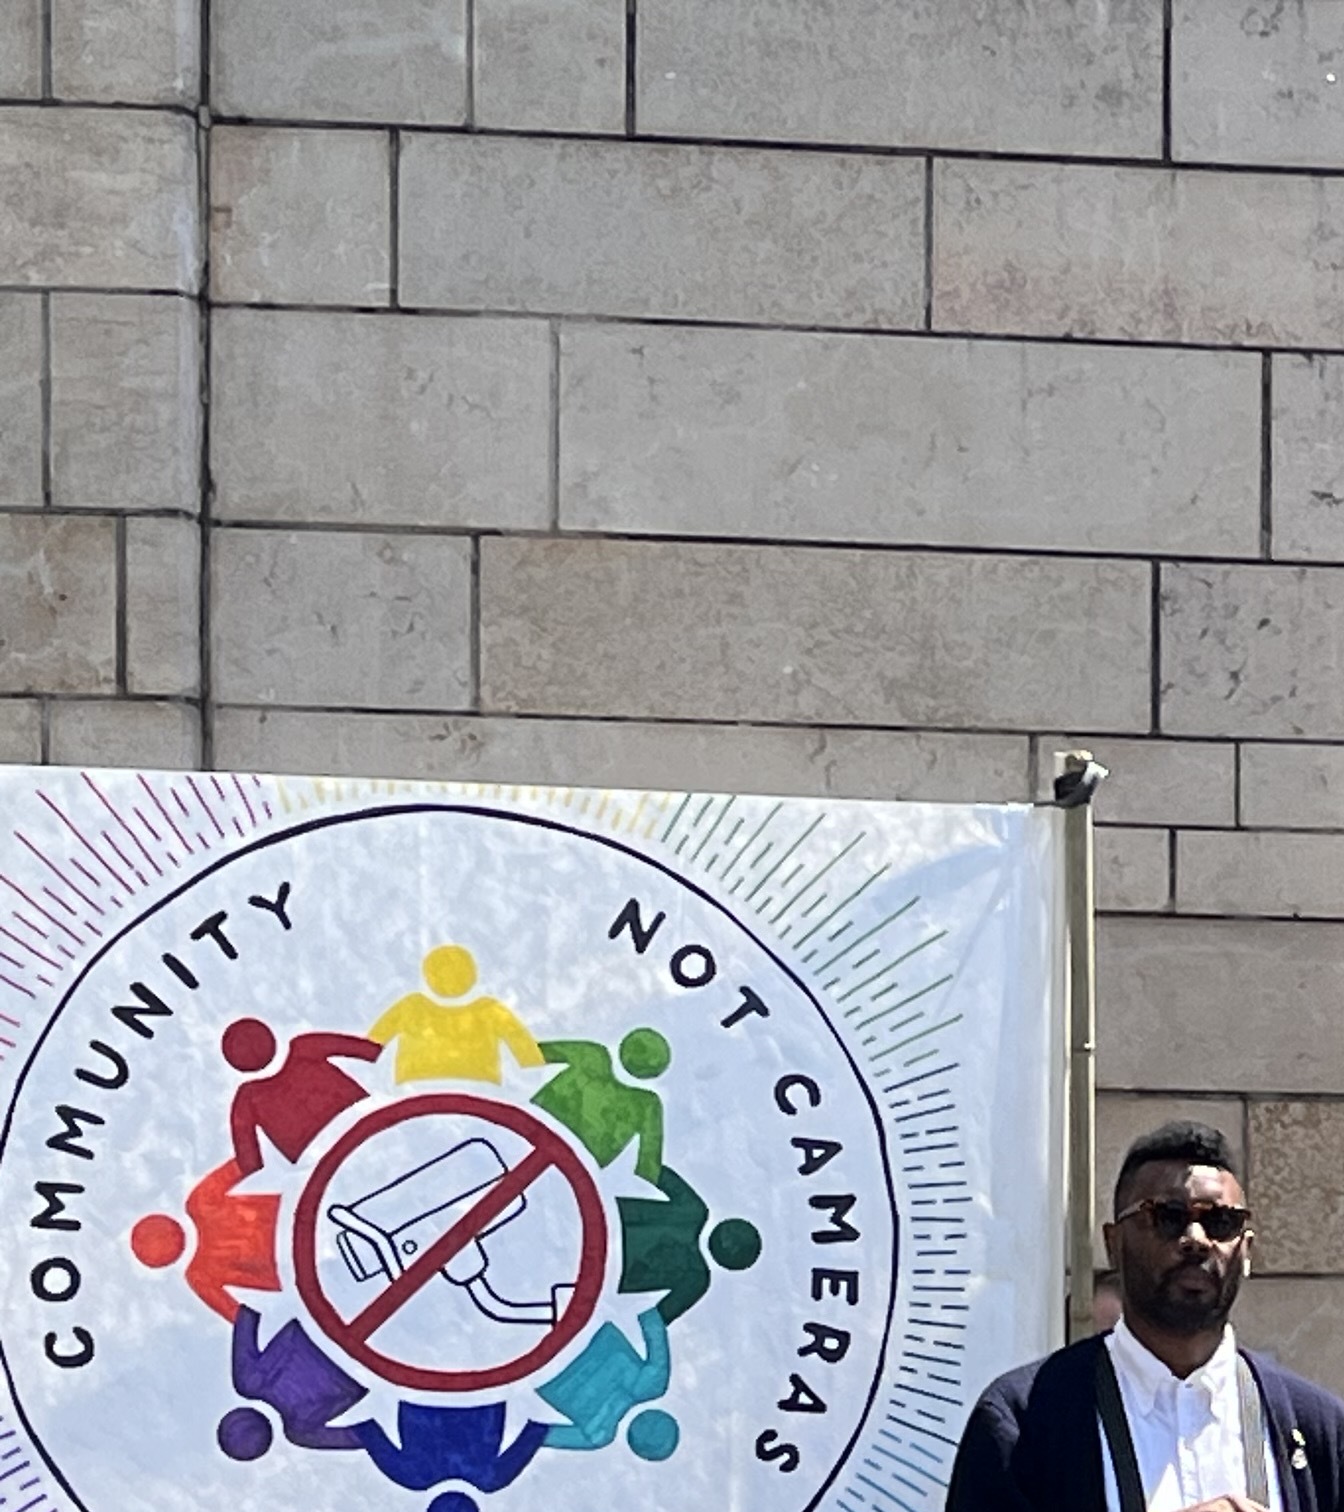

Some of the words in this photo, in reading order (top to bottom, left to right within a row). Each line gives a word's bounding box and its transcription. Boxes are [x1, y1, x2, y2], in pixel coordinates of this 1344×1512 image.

[31, 881, 292, 1367] COMMUNITY
[608, 898, 768, 1028] NOT
[755, 1074, 859, 1473] CAMERAS
